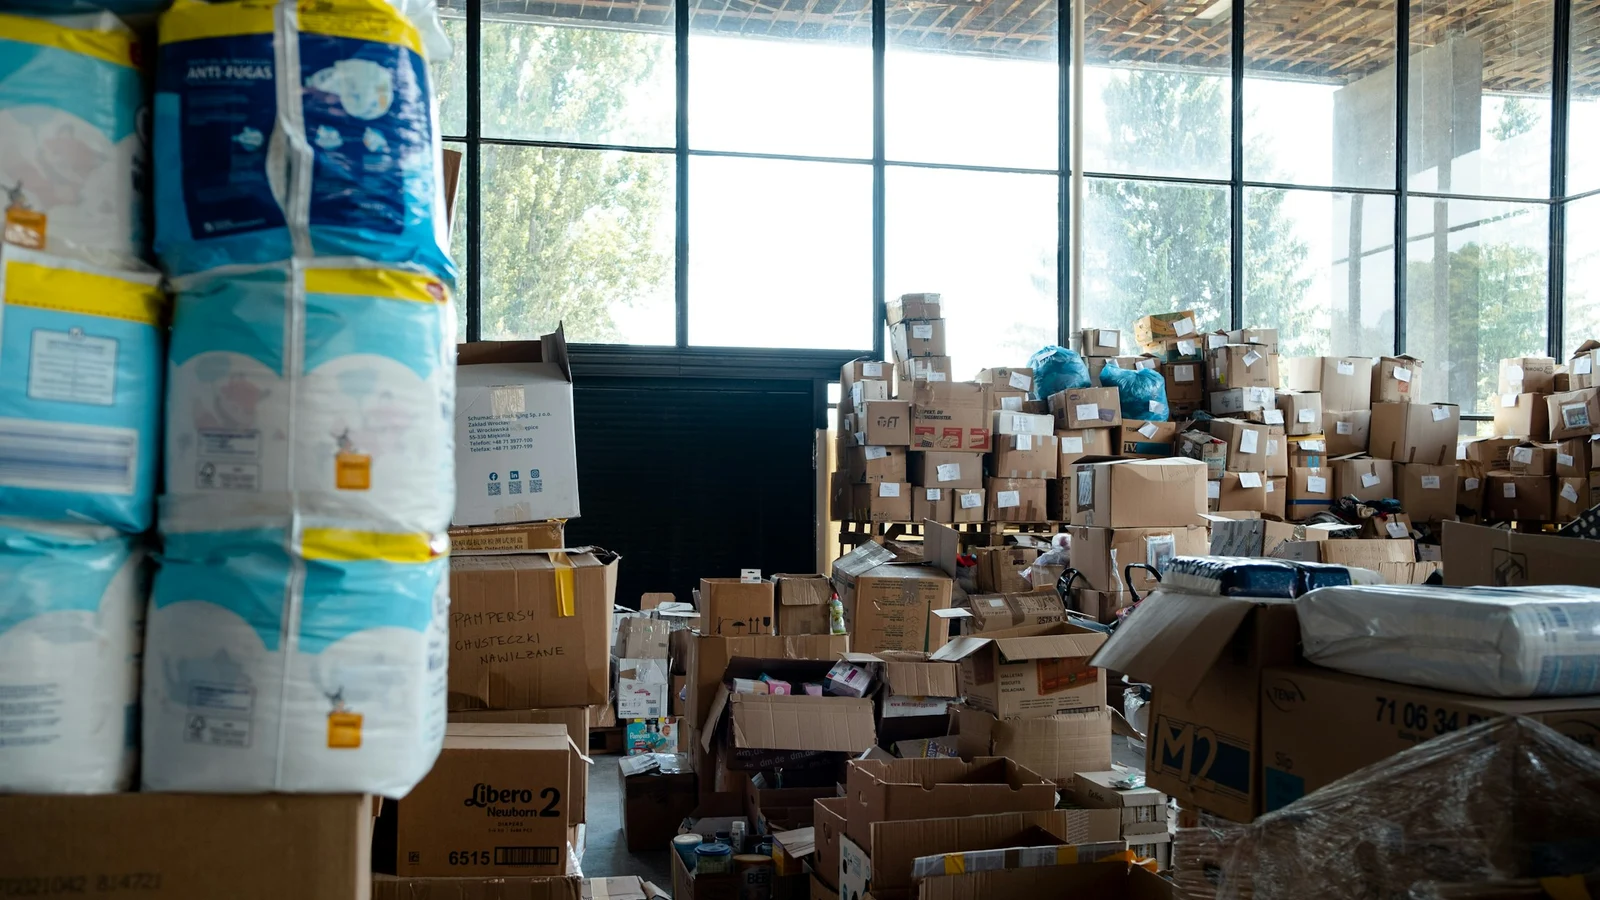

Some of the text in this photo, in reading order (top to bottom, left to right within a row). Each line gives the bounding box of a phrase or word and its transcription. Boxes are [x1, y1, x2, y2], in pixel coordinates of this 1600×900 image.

[455, 633, 540, 651] CHUSTECZKI
[1376, 697, 1396, 725] 71
[1403, 702, 1428, 731] 06
[1433, 708, 1459, 735] 34
[760, 756, 785, 767] dm.de
[790, 750, 815, 760] dm.de
[464, 783, 561, 818] Libero 2
[487, 807, 537, 818] Newborn
[448, 851, 491, 866] 6515
